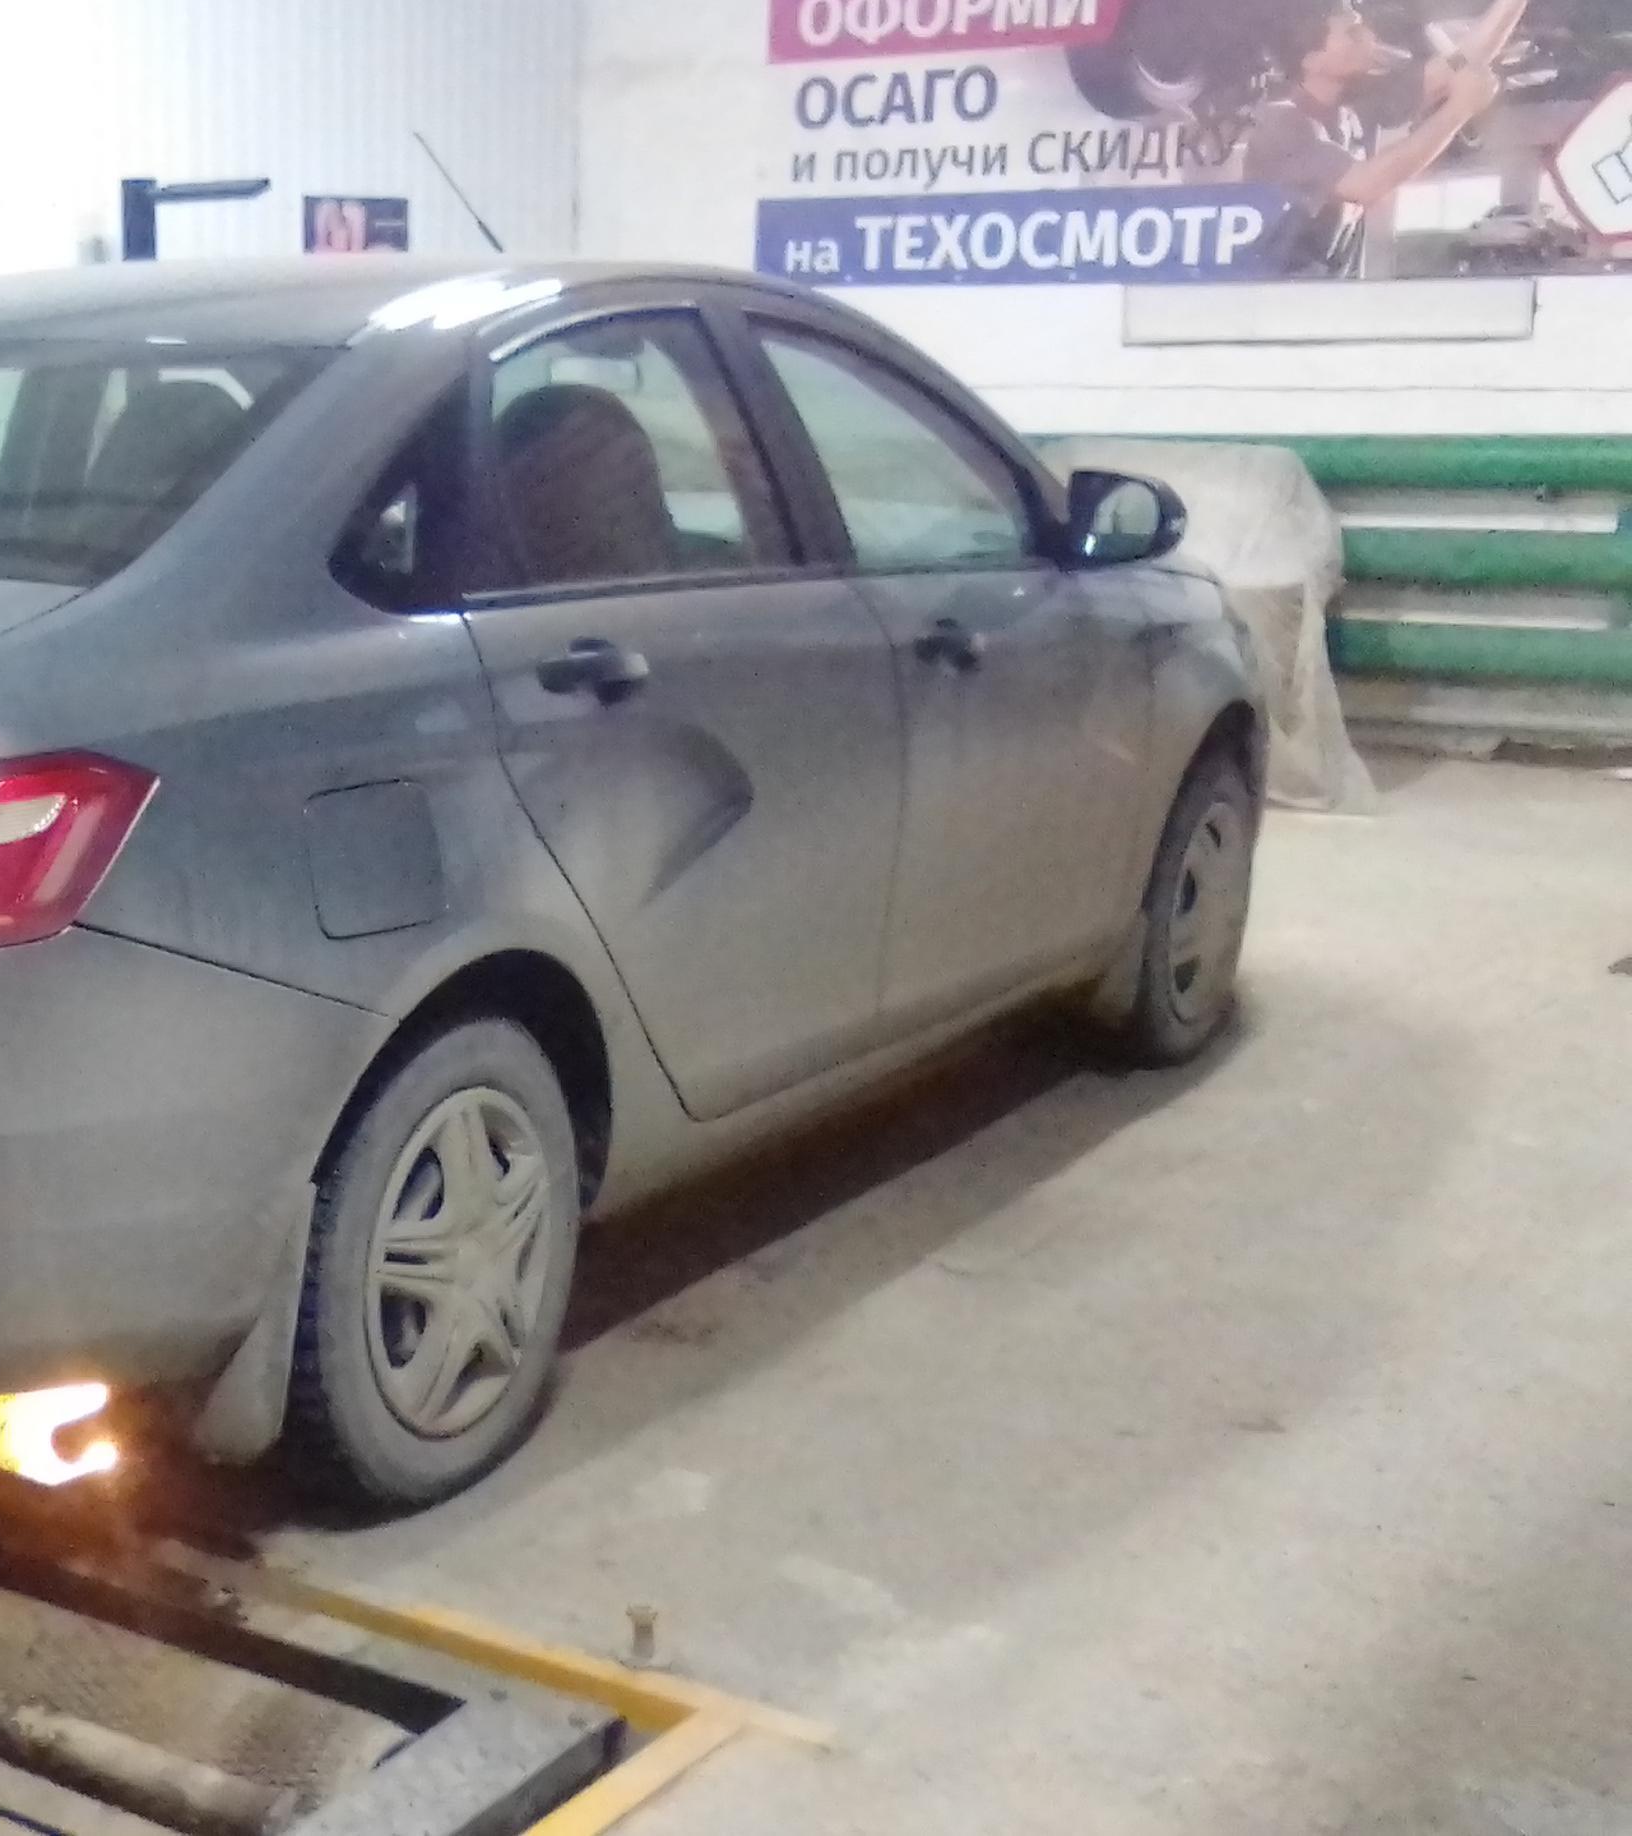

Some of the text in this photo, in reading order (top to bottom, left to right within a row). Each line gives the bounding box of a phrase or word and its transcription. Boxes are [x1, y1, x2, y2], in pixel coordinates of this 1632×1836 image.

[795, 65, 998, 129] ОСАГО
[791, 114, 1255, 190] и получи СКИДКУ
[784, 205, 1264, 273] на ТЕХОСМОТР
